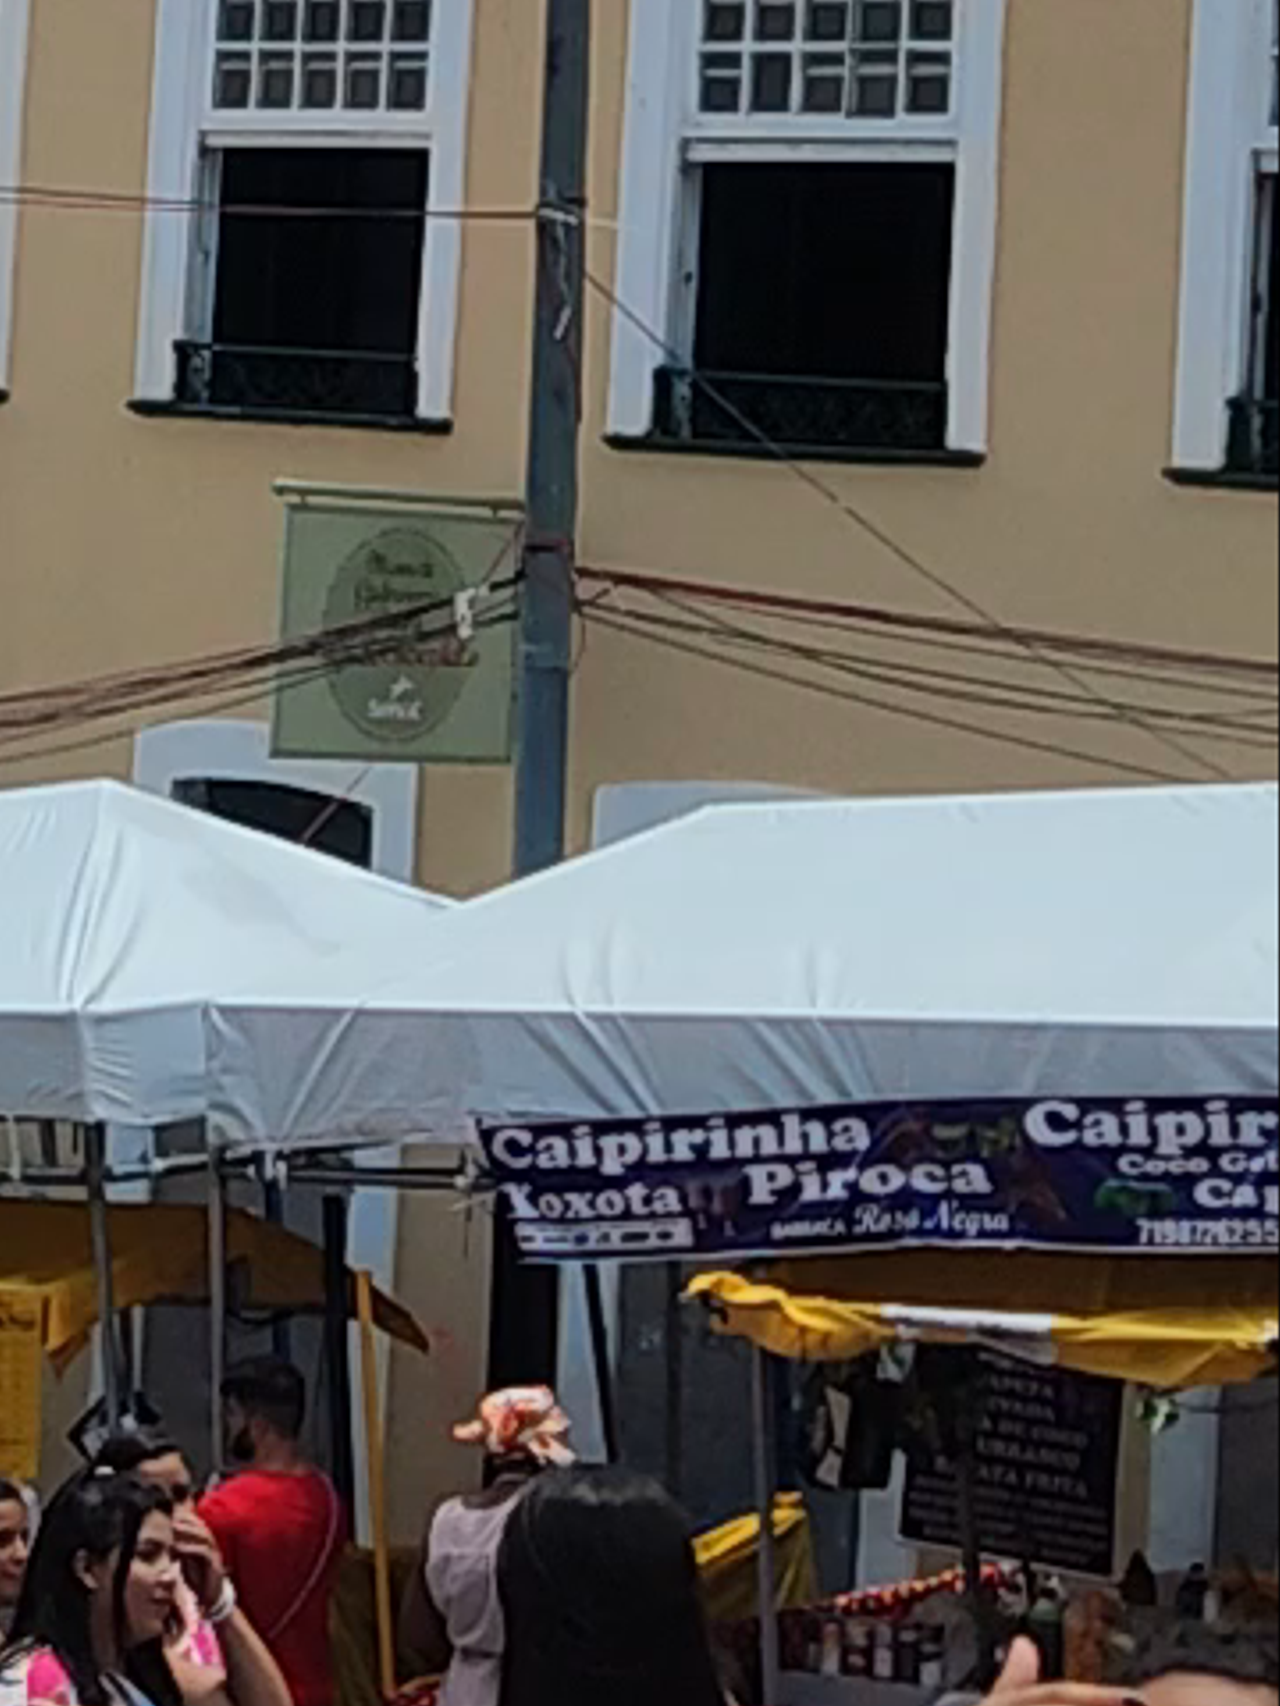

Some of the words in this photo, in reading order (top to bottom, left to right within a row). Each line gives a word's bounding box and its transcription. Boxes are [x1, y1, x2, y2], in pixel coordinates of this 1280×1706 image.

[491, 1113, 871, 1175] Caipirinha
[1116, 1153, 1210, 1175] Coco
[742, 1160, 994, 1204] Piroca
[852, 1203, 920, 1234] Rosa
[924, 1200, 1009, 1237] Negra
